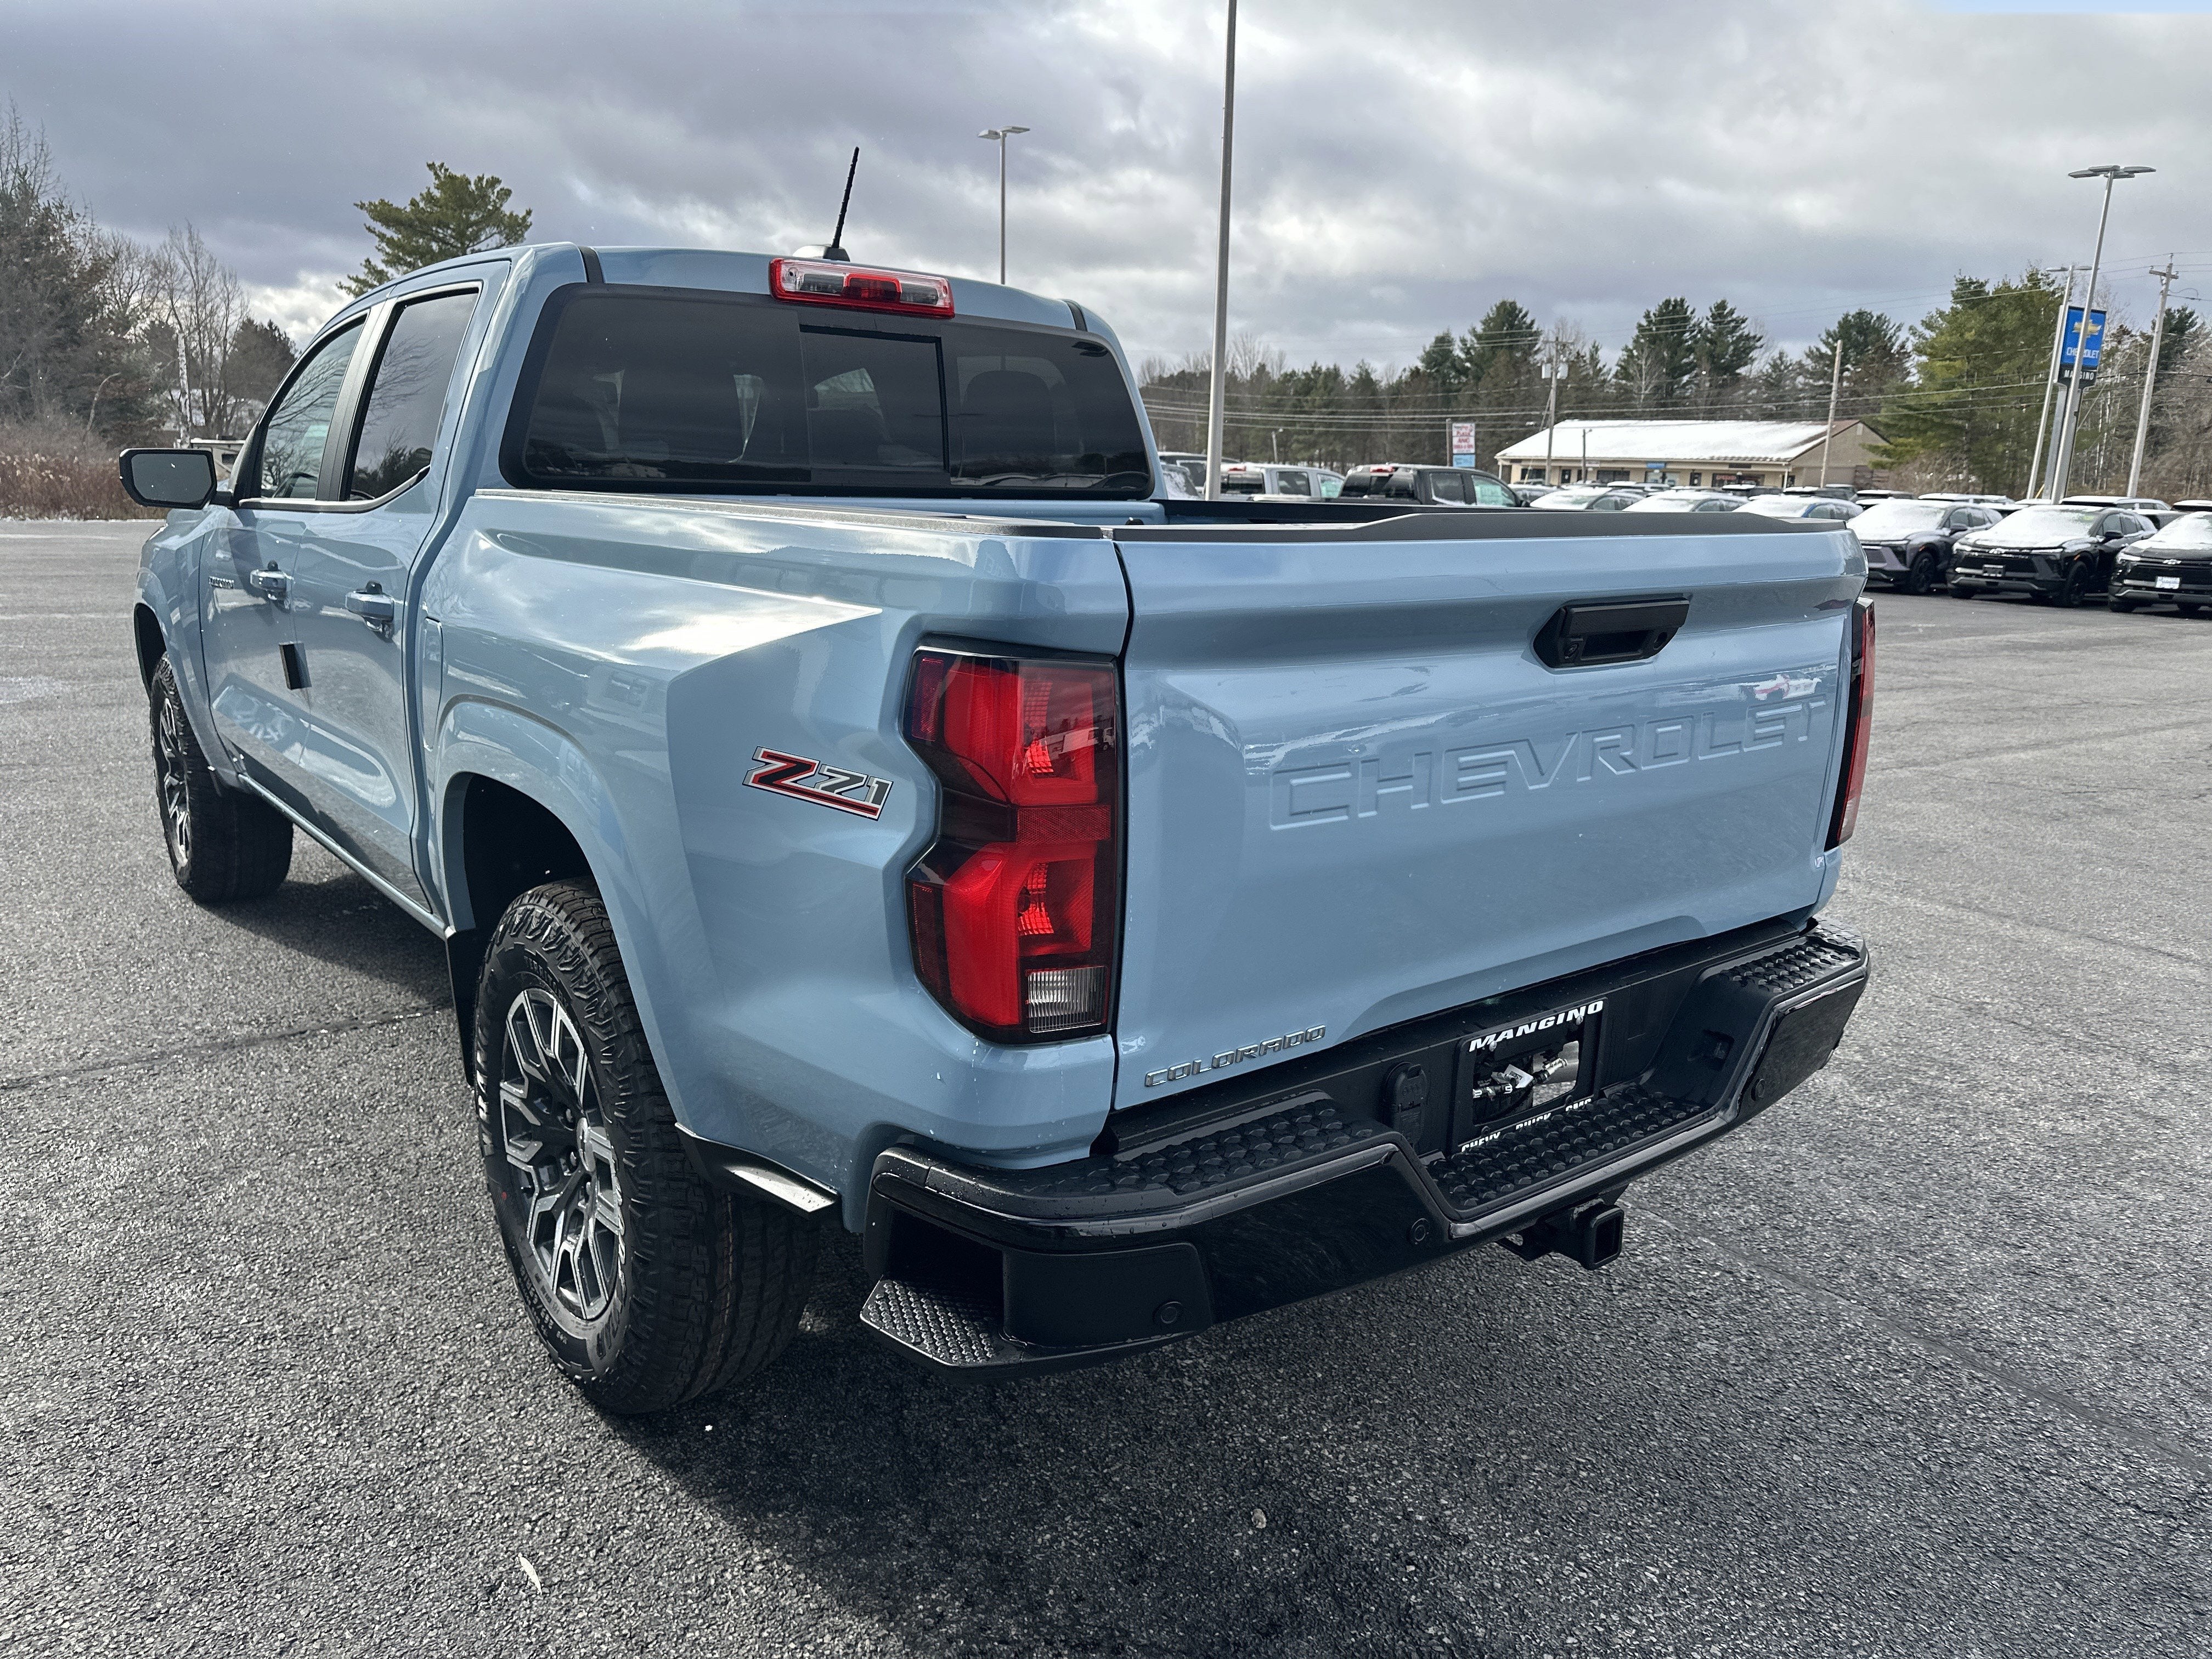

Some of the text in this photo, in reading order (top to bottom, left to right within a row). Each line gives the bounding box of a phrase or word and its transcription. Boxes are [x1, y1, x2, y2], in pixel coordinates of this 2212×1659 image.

[2064, 370, 2094, 380] MAGINO
[2067, 347, 2100, 358] CHEOLET
[742, 746, 894, 821] Z71
[1269, 695, 1826, 831] CHEVROLET
[1469, 1000, 1604, 1052] MANGINO
[1144, 1024, 1326, 1087] COLORADO
